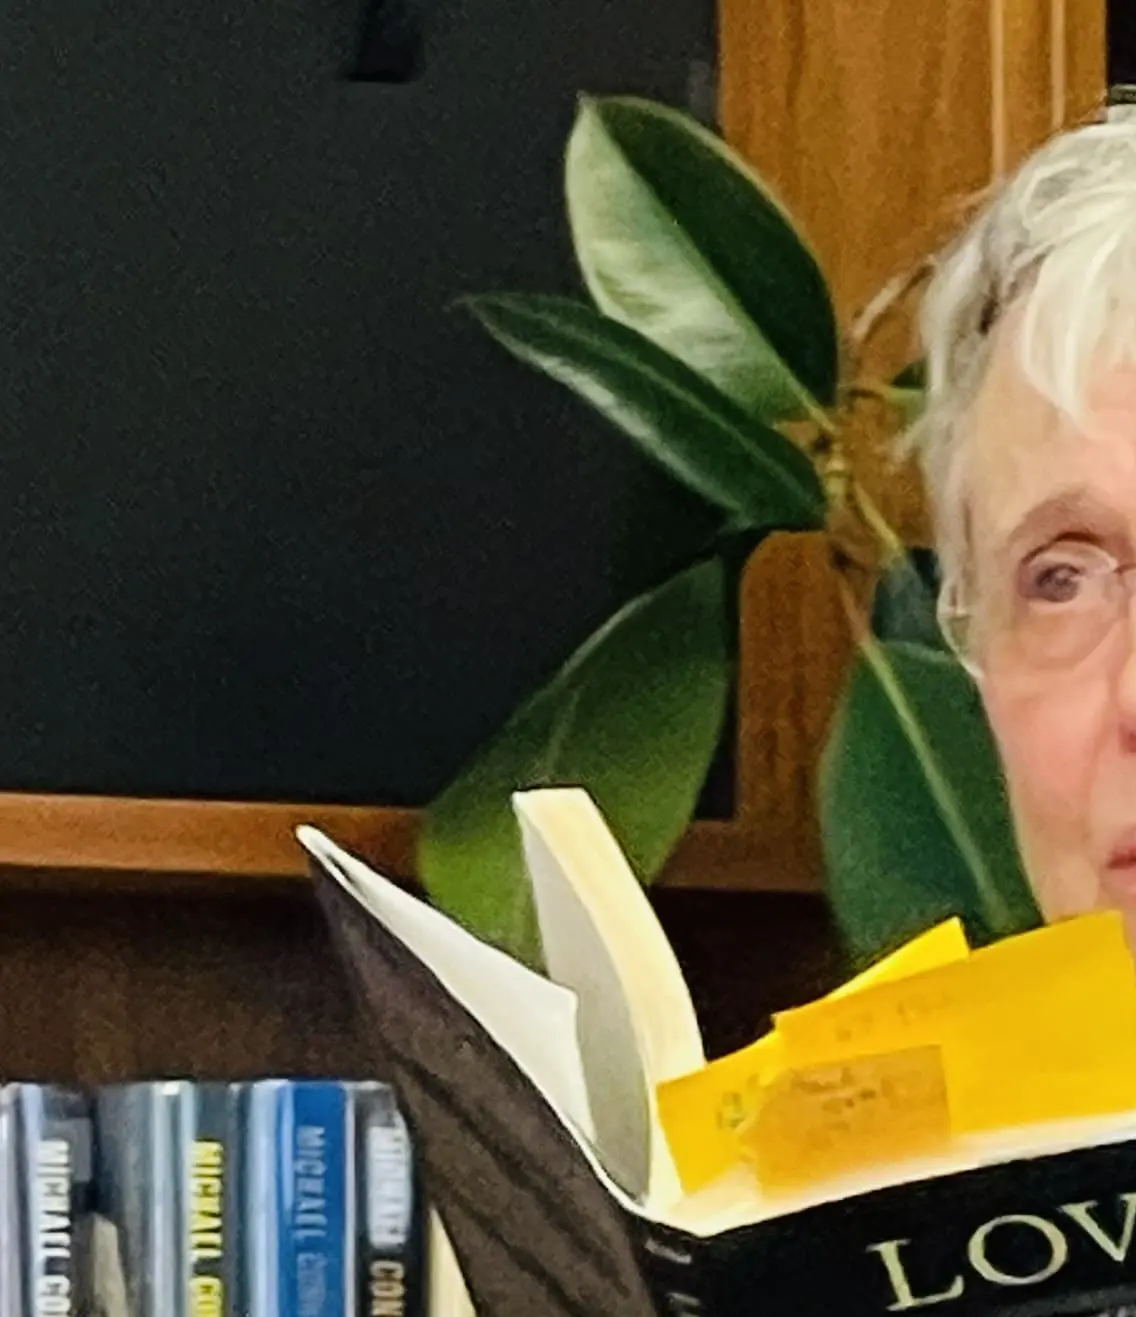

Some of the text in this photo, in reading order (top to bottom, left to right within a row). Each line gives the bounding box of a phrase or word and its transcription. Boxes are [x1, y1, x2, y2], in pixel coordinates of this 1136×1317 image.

[38, 1139, 71, 1260] MICHAEL
[190, 1139, 223, 1260] MICHAEL
[293, 1125, 326, 1238] MICHAEL
